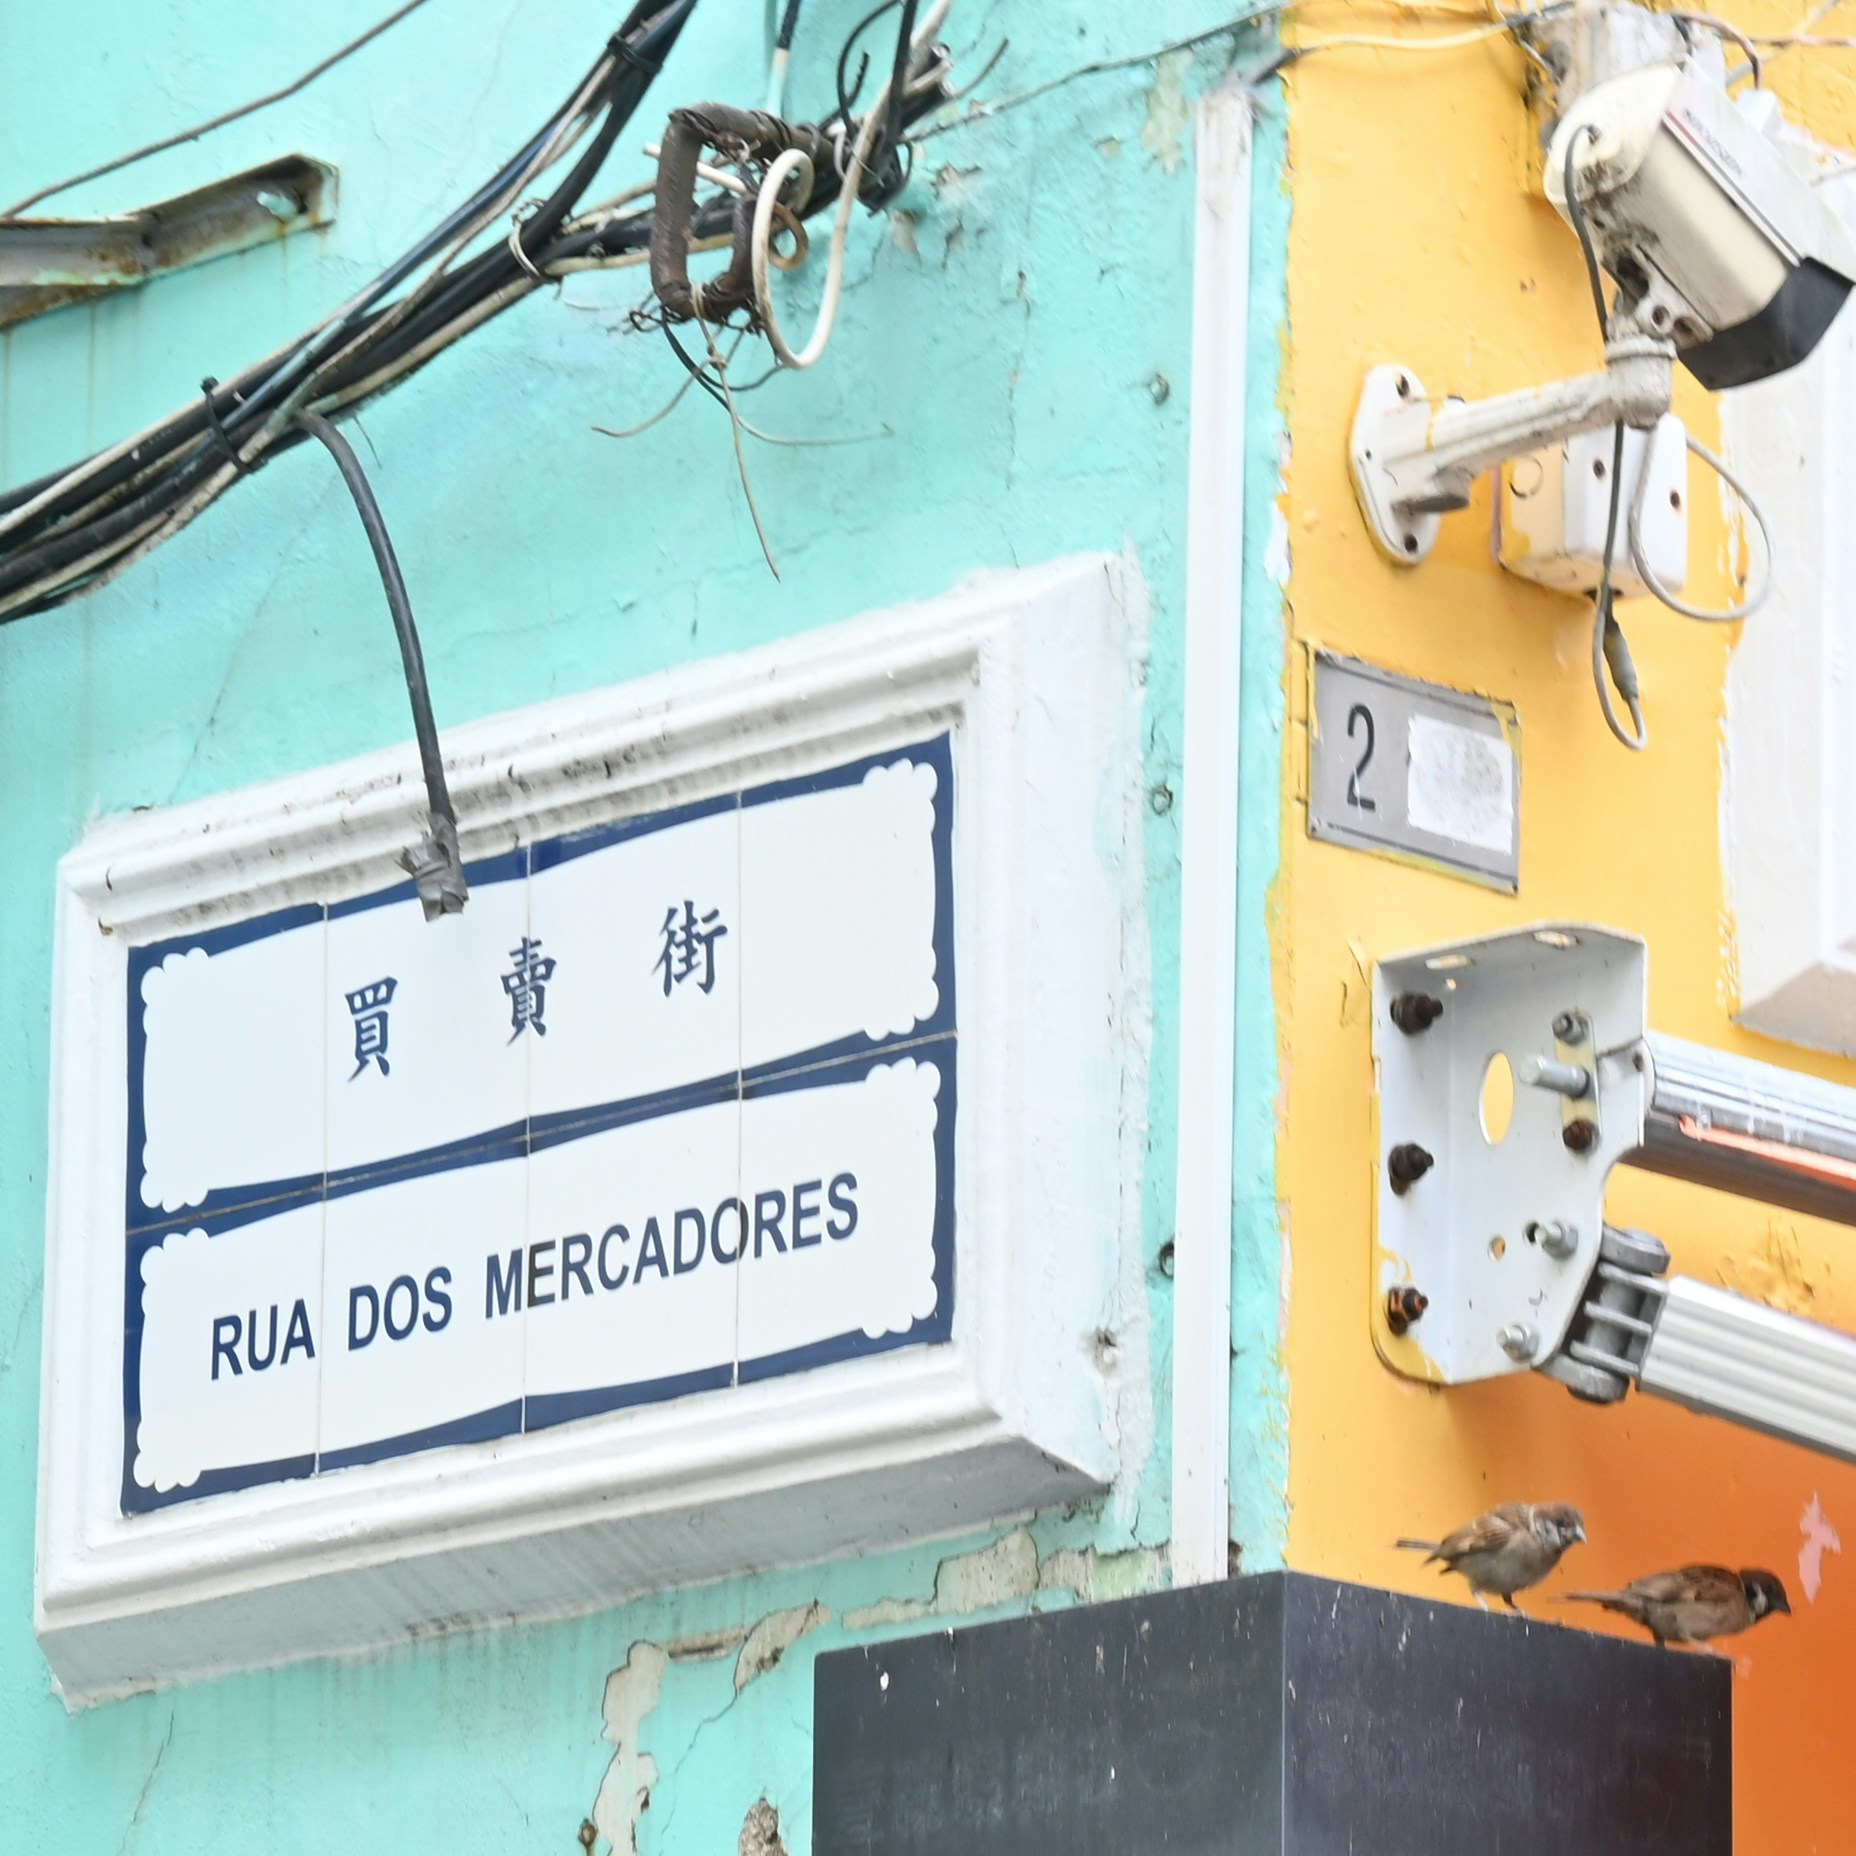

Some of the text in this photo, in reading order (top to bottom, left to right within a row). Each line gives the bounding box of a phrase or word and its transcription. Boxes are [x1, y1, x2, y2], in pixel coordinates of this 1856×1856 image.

[1346, 703, 1376, 813] 2
[343, 899, 728, 1082] 買賣街
[210, 1172, 858, 1381] RUA DOS MERCADORES
